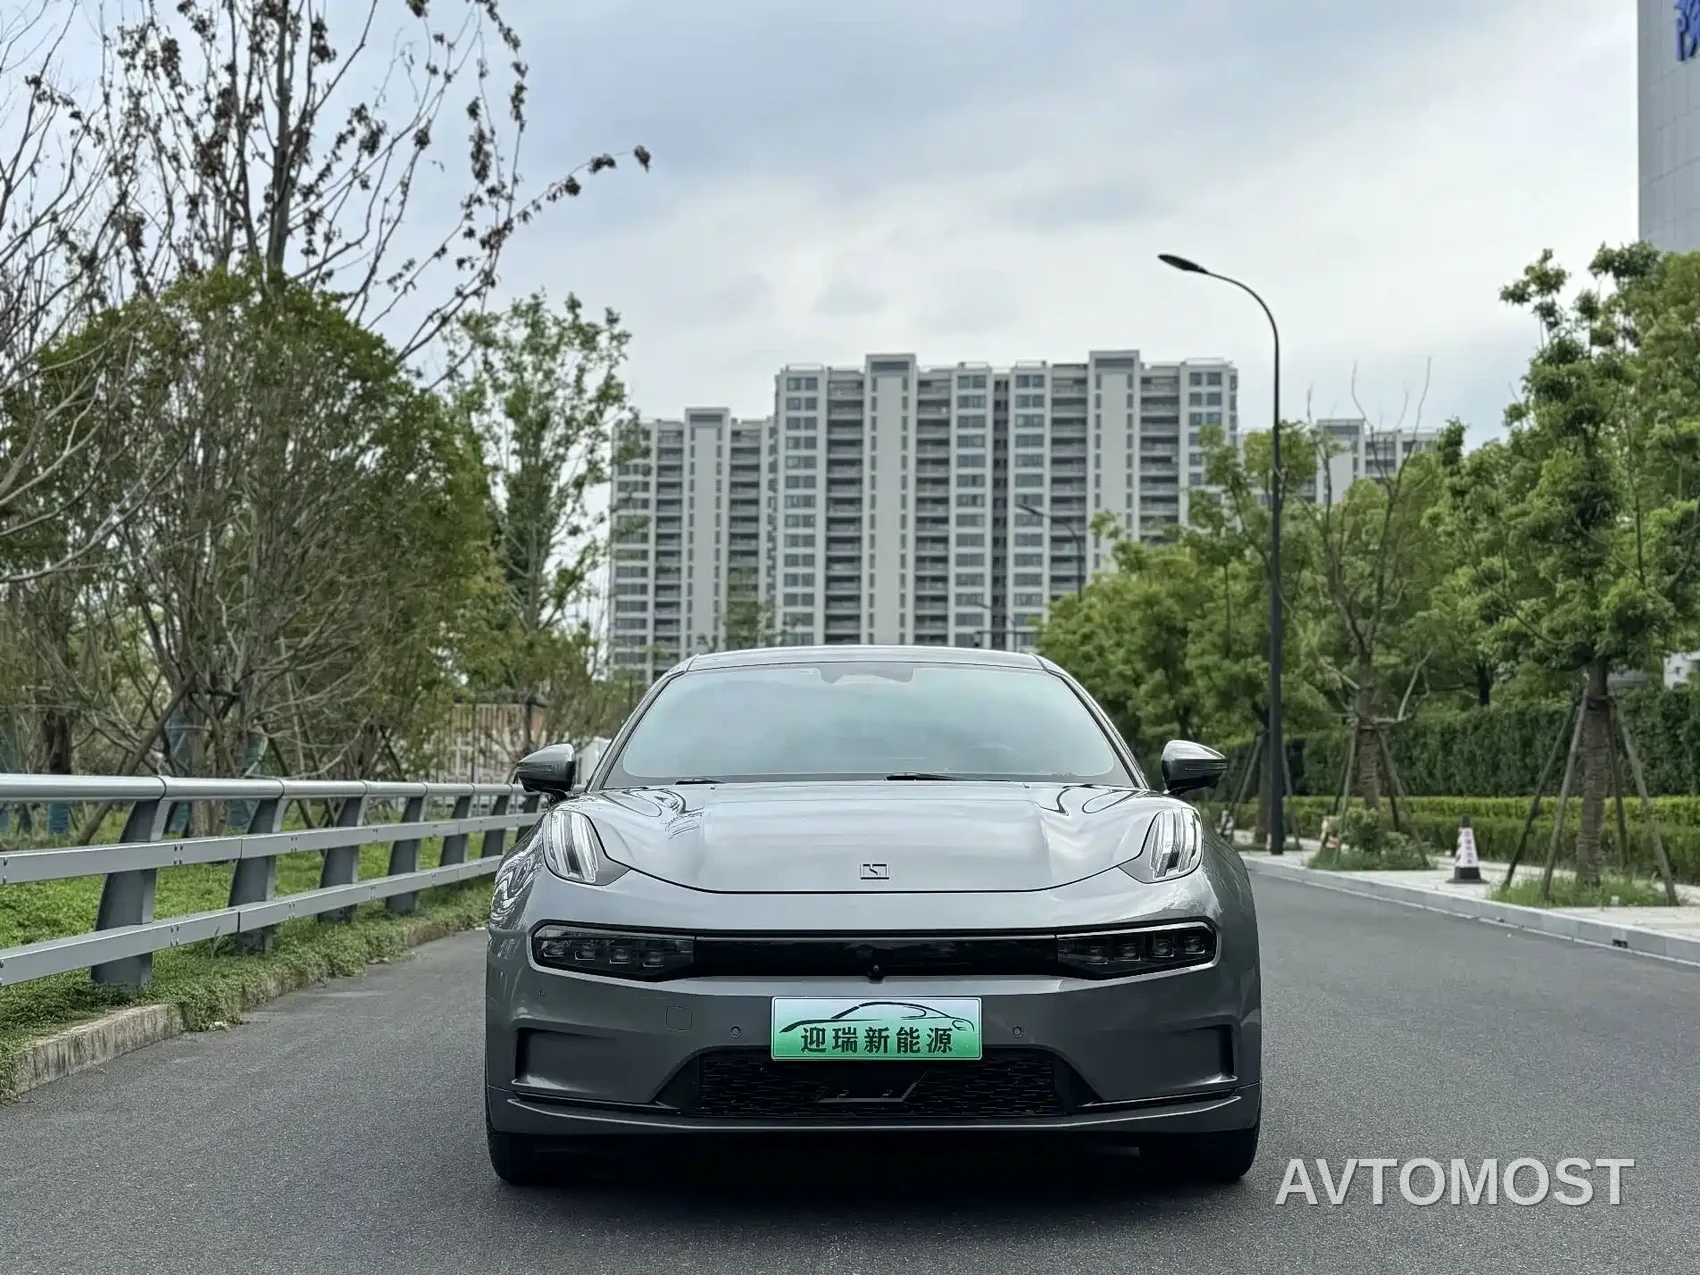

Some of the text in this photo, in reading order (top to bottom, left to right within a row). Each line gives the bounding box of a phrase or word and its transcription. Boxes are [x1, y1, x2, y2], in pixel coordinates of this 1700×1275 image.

[801, 1026, 953, 1054] 迎瑞新能源
